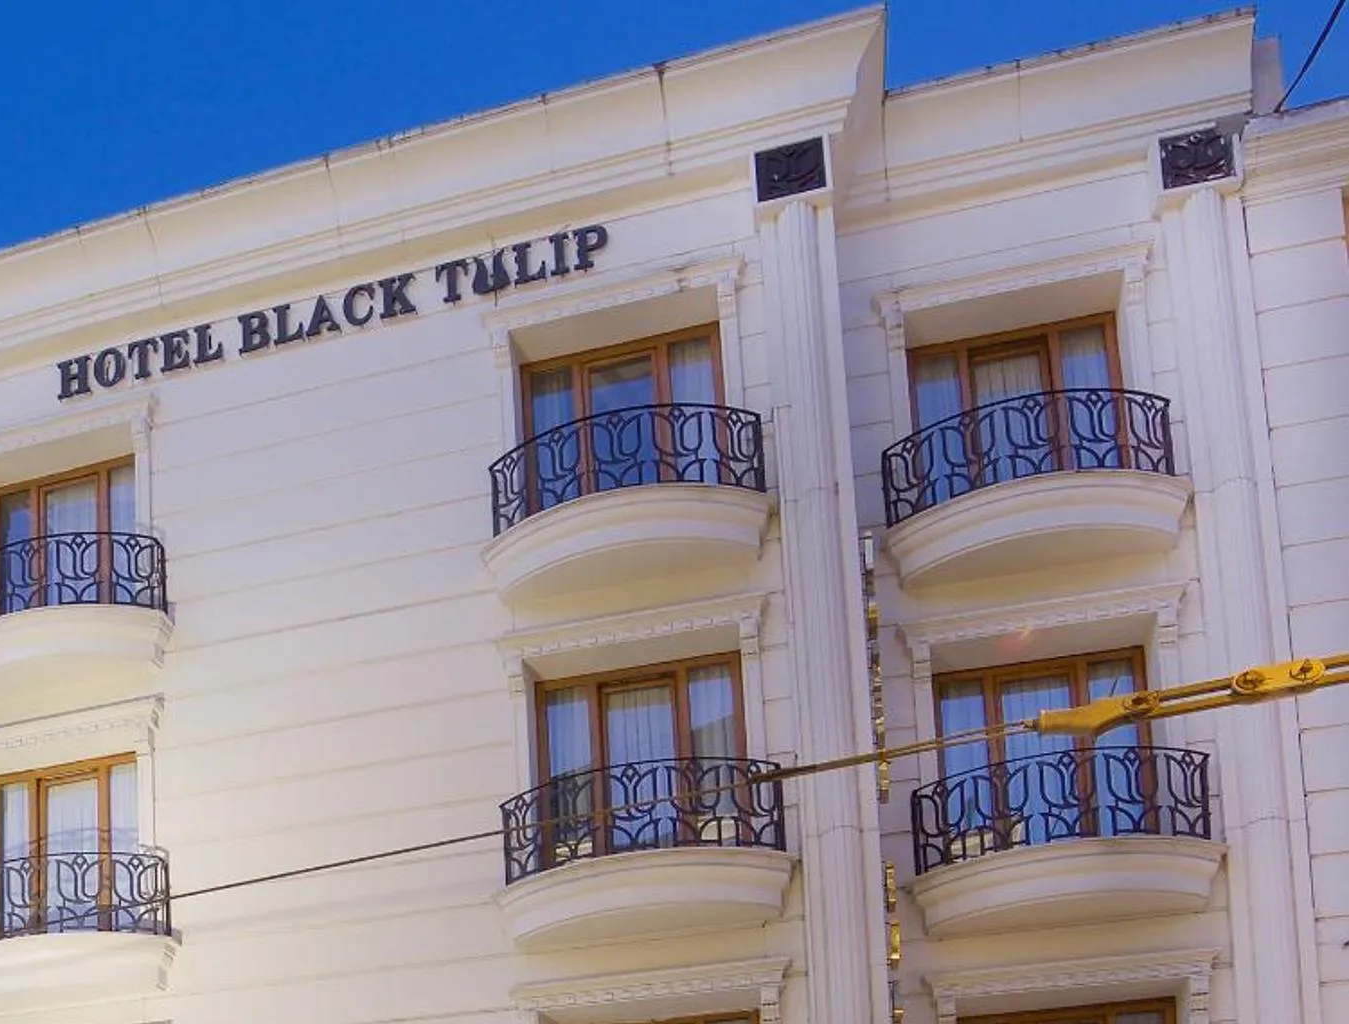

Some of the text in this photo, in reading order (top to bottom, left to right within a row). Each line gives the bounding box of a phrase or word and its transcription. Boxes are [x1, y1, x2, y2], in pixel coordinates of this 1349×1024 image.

[56, 224, 609, 401] HOTEL BLACK TULIP
